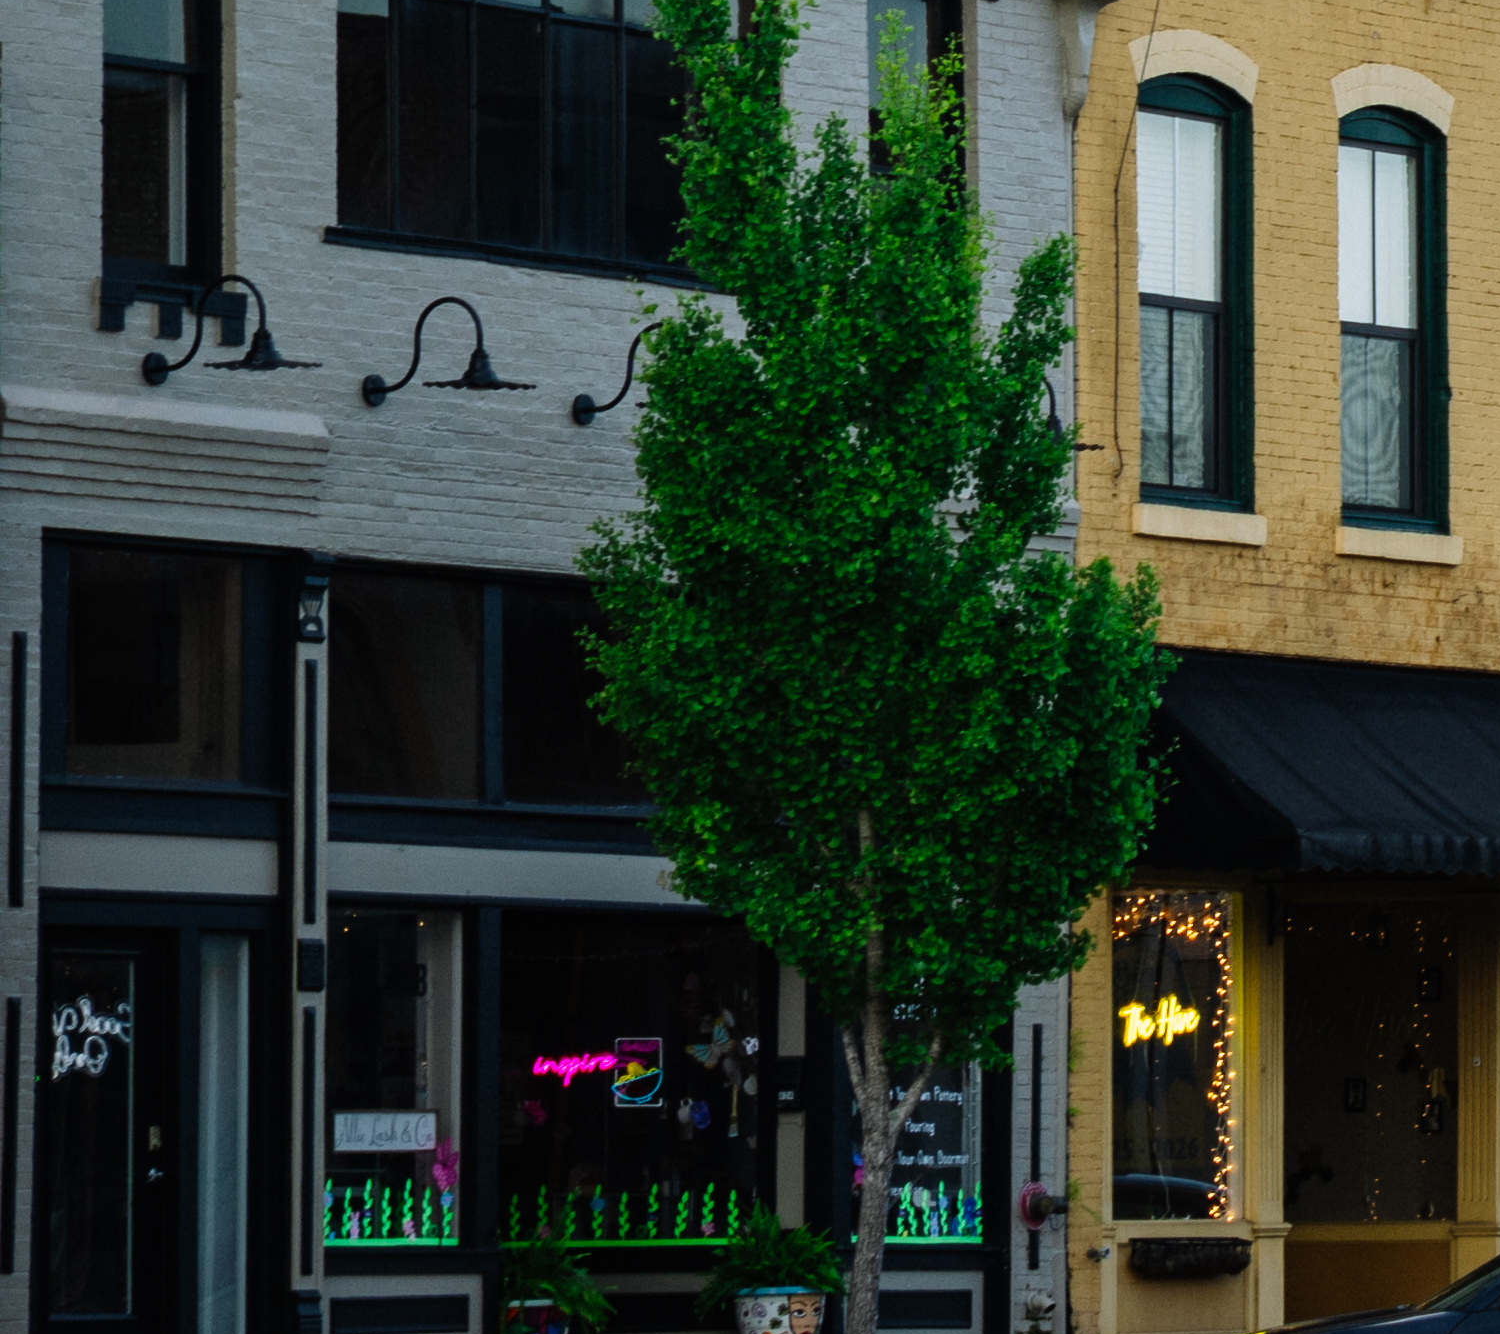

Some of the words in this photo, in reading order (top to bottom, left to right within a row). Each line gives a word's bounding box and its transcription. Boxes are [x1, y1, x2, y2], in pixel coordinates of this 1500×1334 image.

[1118, 1001, 1157, 1048] The
[1156, 993, 1201, 1047] Hive
[532, 1052, 620, 1088] inspire
